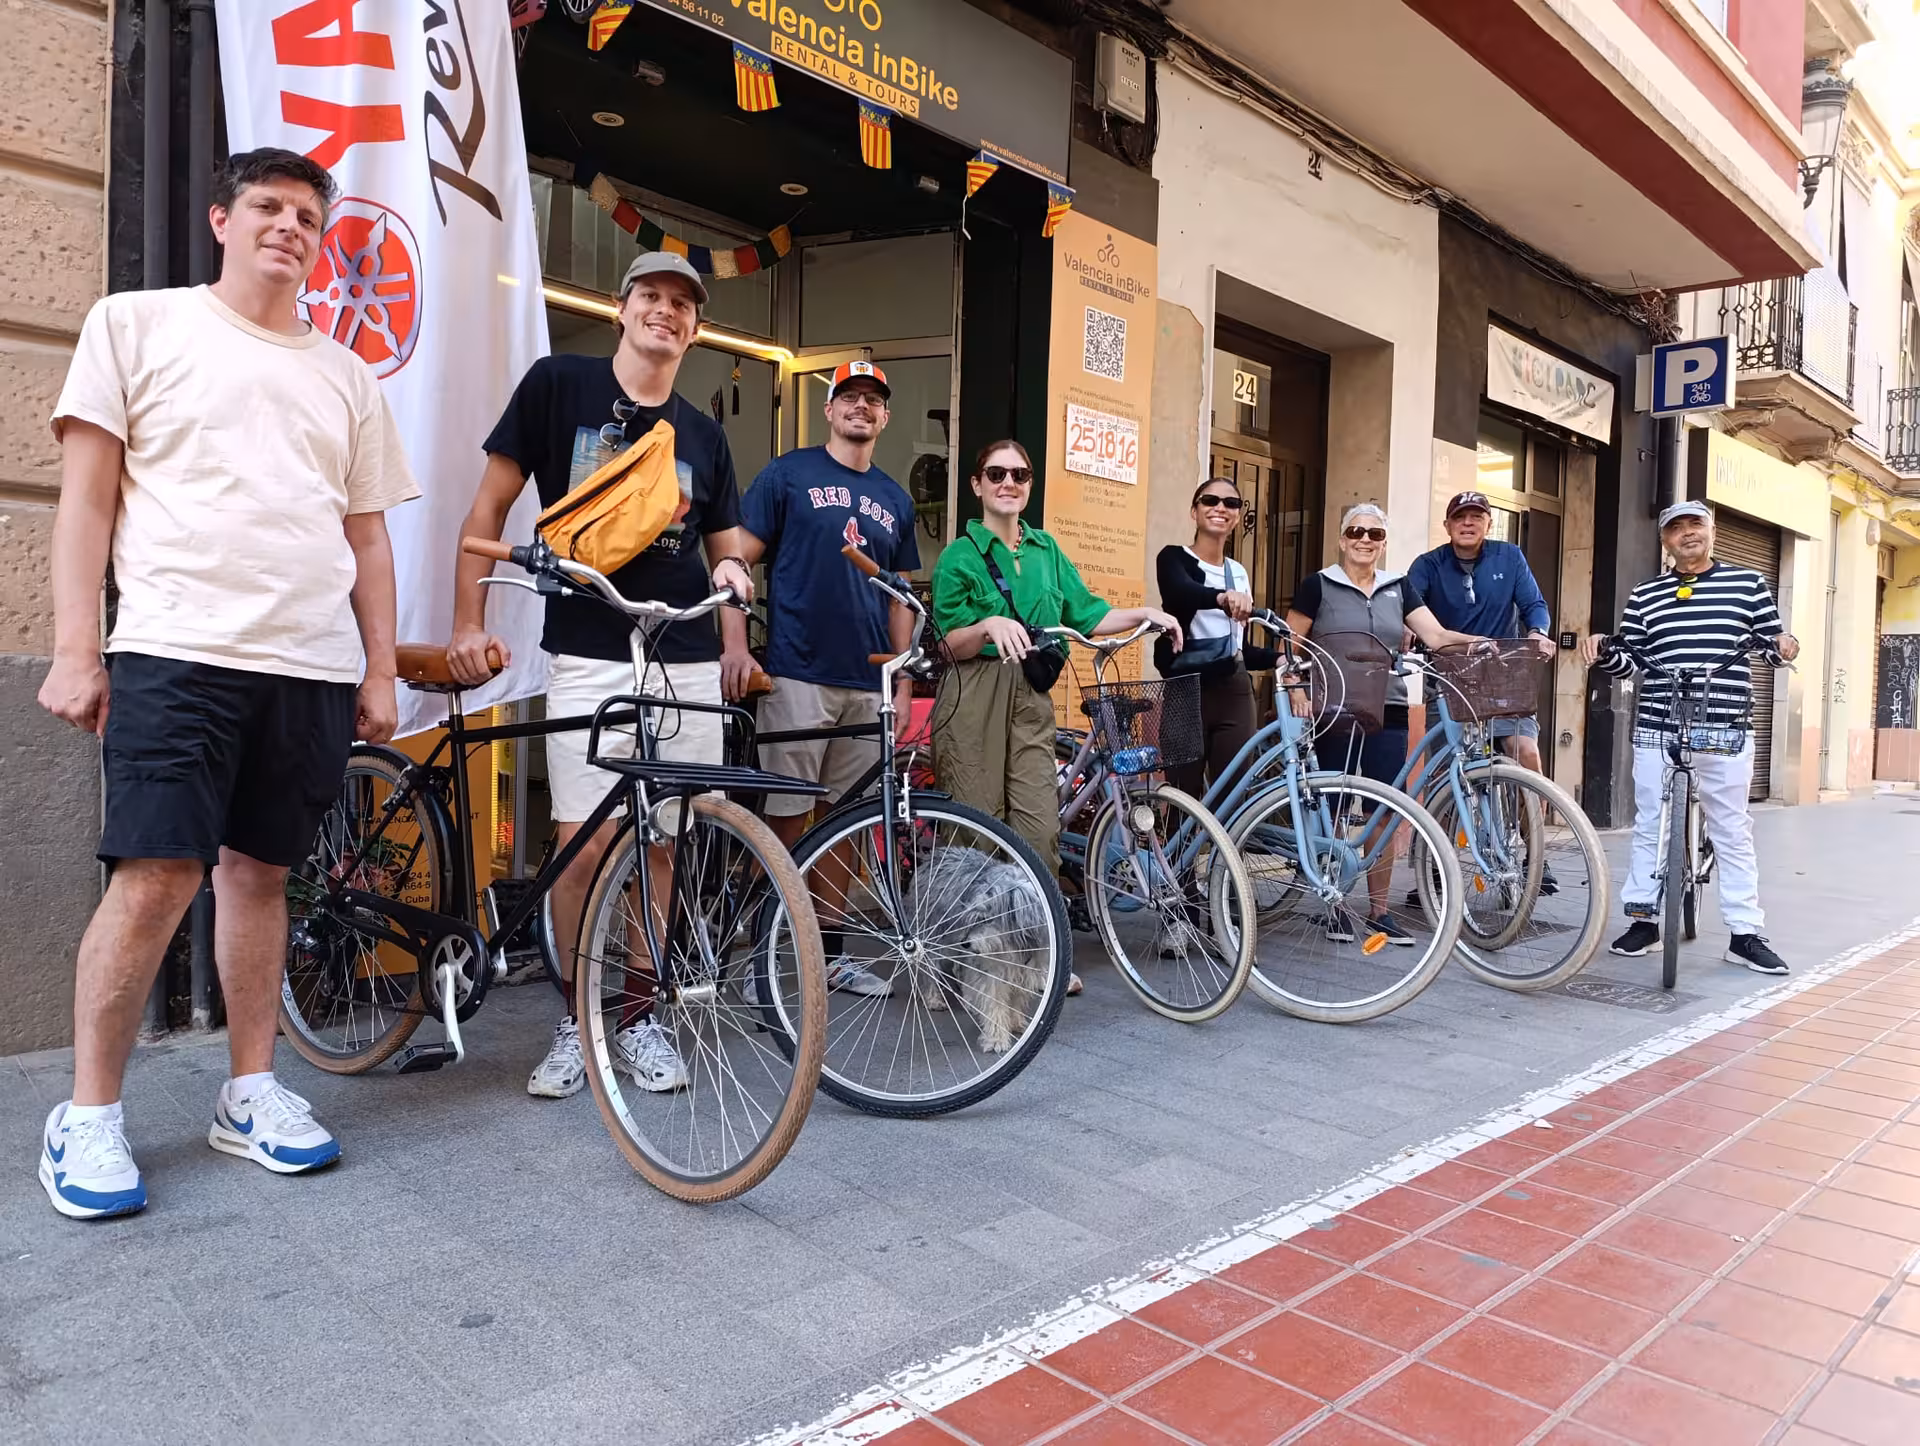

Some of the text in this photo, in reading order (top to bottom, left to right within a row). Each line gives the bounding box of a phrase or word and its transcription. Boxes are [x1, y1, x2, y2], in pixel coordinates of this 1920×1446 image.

[697, 7, 709, 19] 11
[712, 13, 724, 27] 02
[731, 0, 959, 110] alencia inBike
[774, 36, 917, 113] RENTAL & TOURS
[1309, 151, 1322, 177] 24
[1064, 251, 1150, 298] Valencia inBike
[1234, 372, 1256, 403] 24
[1664, 347, 1718, 407] P
[1692, 382, 1710, 392] 24h
[1071, 423, 1096, 452] 25
[1098, 430, 1116, 459] 18
[1118, 436, 1137, 468] 16
[808, 486, 895, 529] RED SOX
[1084, 563, 1105, 574] RENTAL
[405, 895, 430, 904] Cuba
